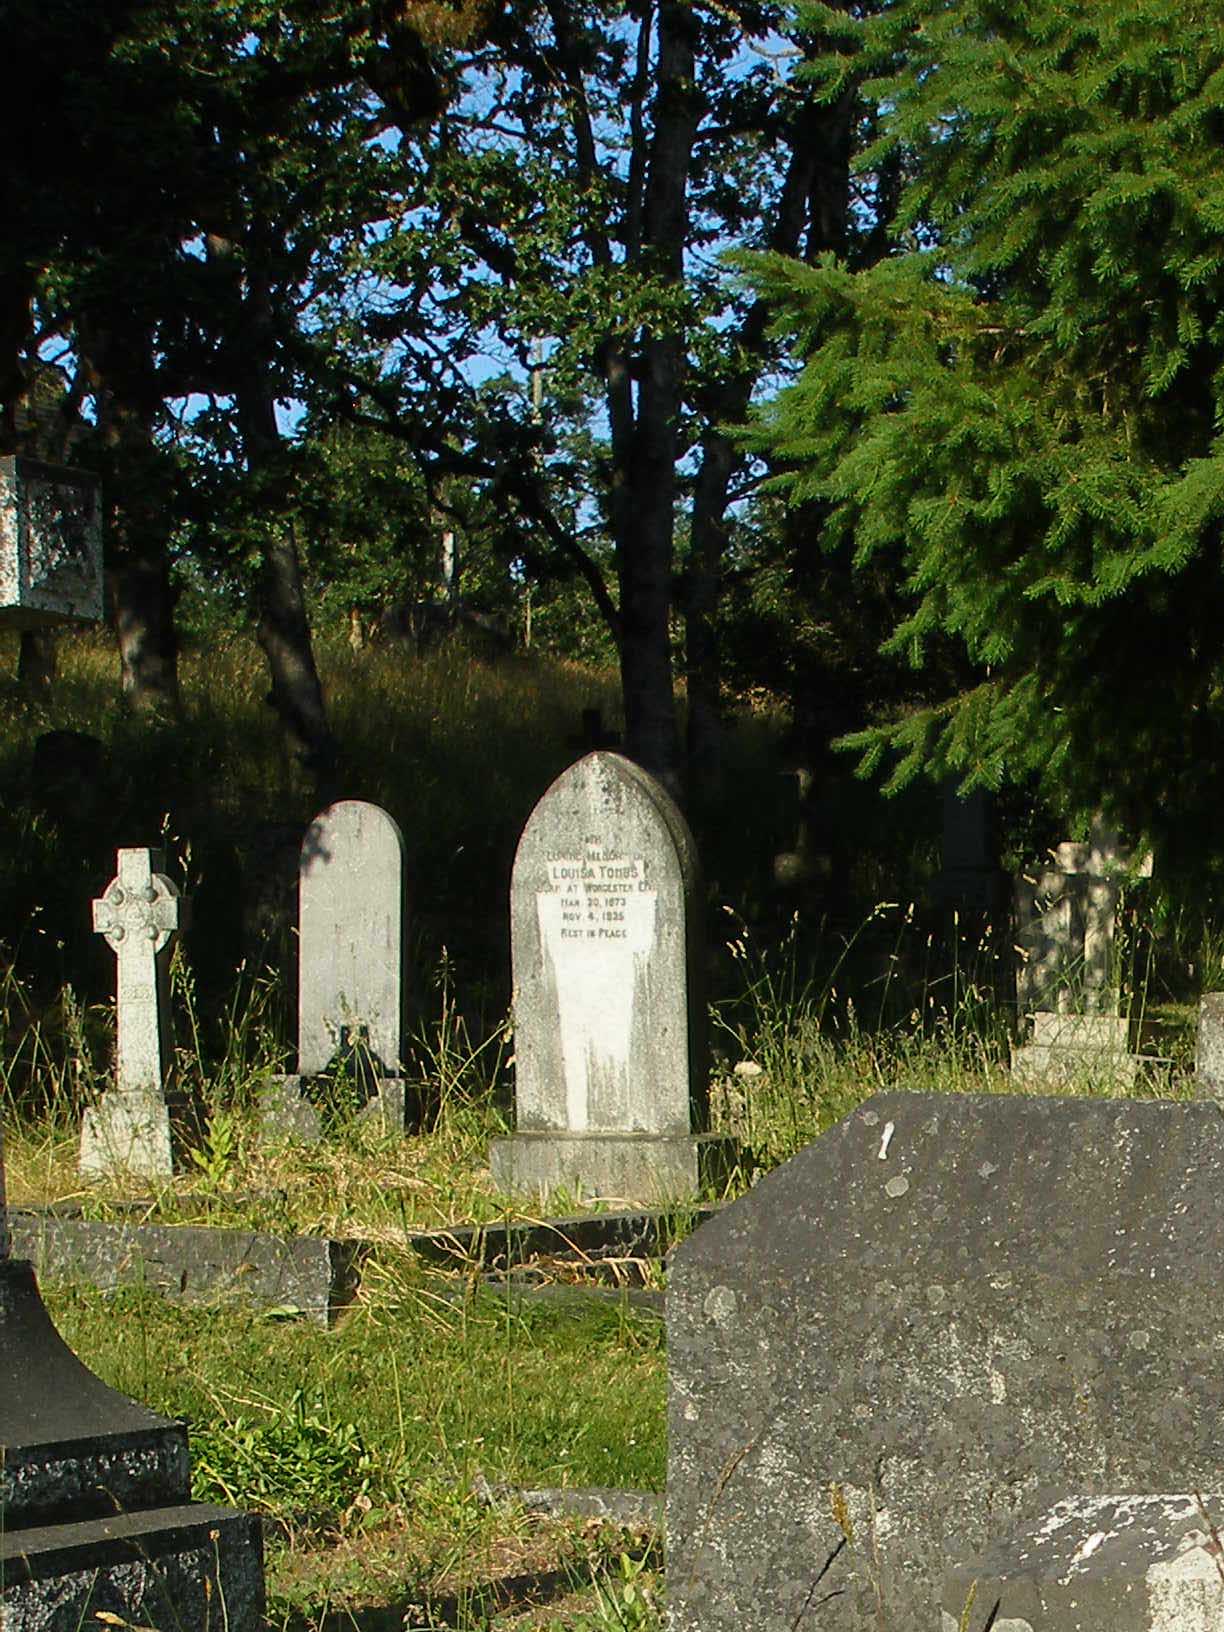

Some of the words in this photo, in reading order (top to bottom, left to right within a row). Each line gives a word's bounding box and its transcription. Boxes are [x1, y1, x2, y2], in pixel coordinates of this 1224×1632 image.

[552, 866, 596, 879] LOUISA
[566, 884, 579, 894] AT
[583, 884, 634, 894] WORCESTER
[560, 928, 583, 939] REST
[587, 929, 596, 938] IN
[598, 928, 627, 938] PEACE
